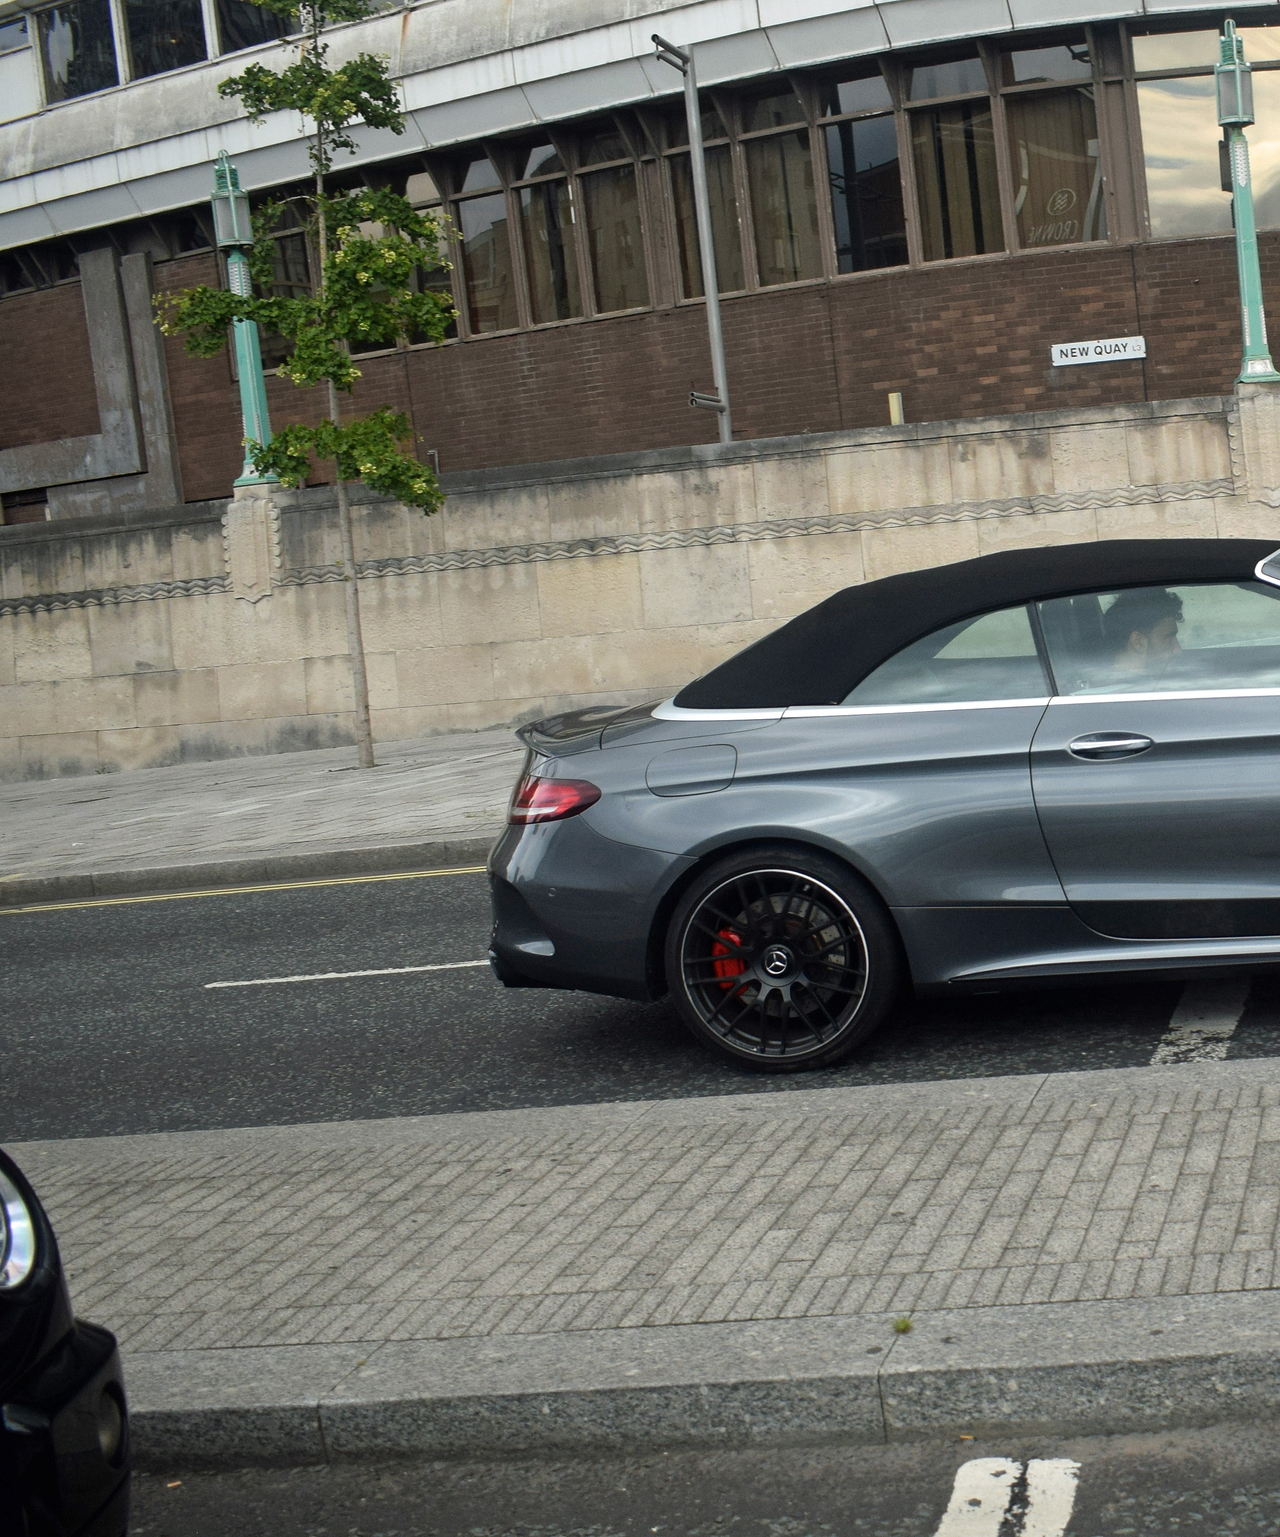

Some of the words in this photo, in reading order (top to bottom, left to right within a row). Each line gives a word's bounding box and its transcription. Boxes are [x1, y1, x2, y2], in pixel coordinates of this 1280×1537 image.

[1060, 346, 1089, 358] NEW
[1094, 342, 1128, 355] QUAY
[1132, 344, 1142, 352] L3
